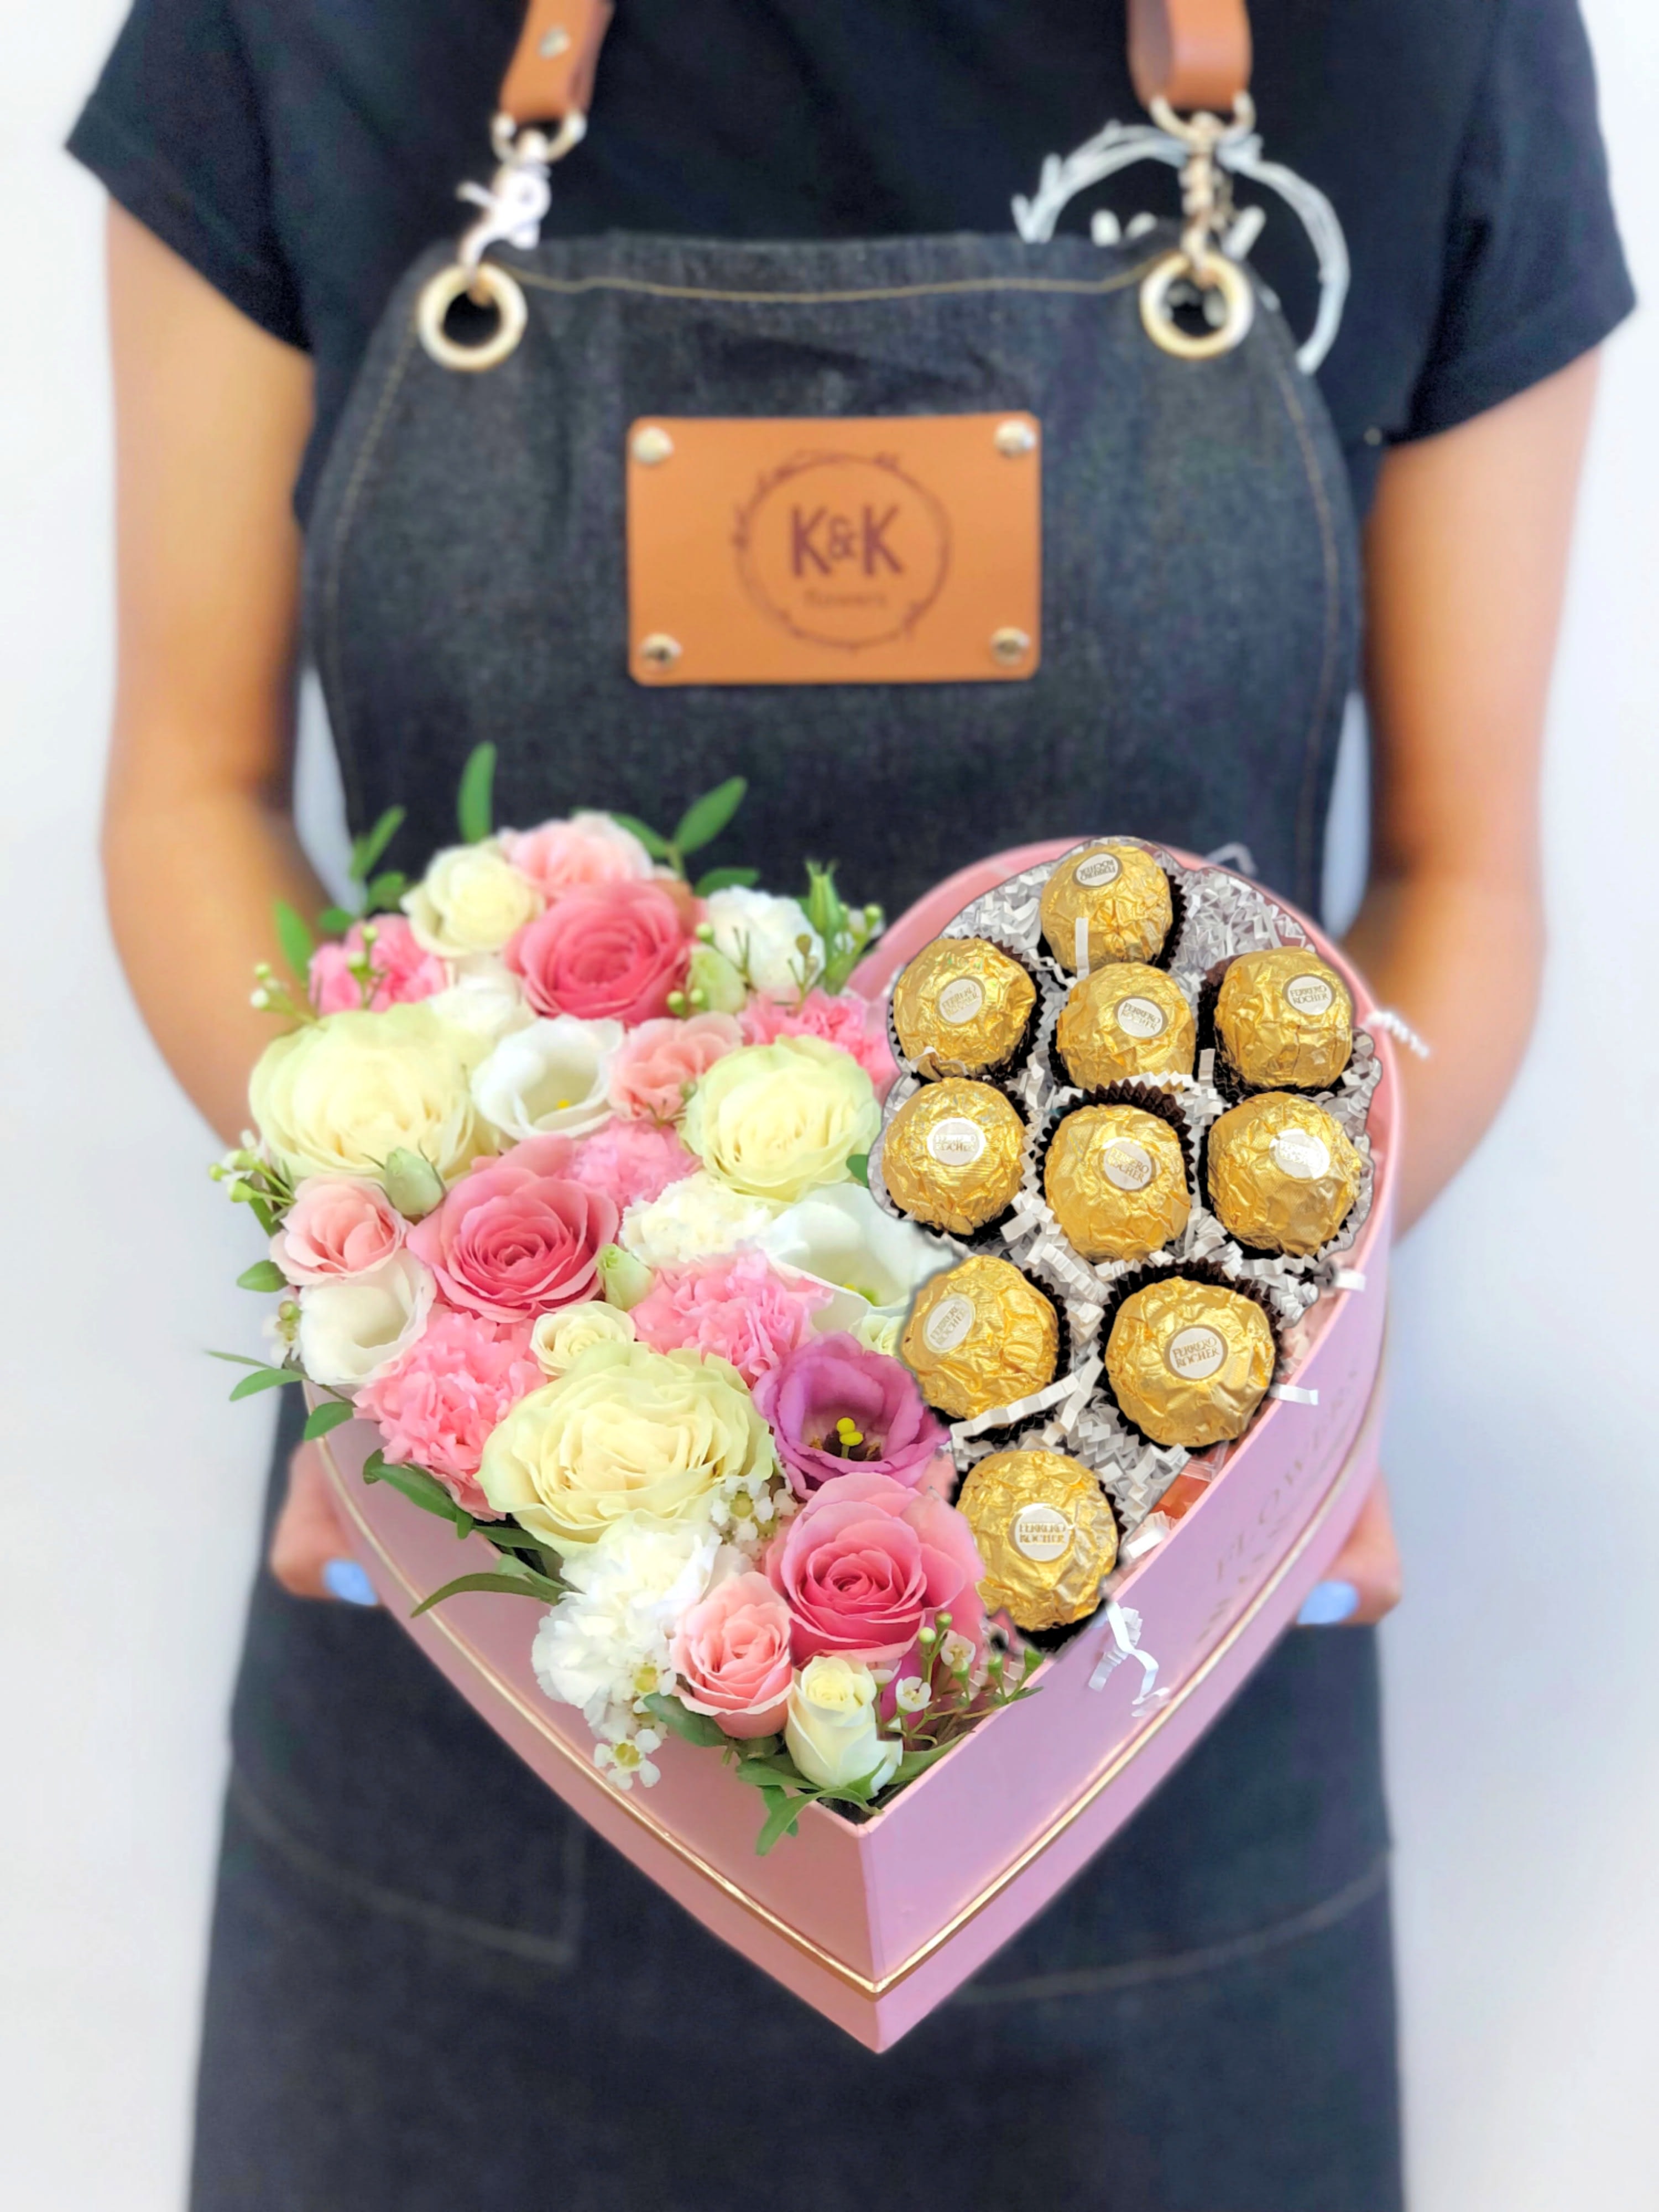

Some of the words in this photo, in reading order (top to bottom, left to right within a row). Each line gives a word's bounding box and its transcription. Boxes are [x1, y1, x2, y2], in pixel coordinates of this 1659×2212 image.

[791, 504, 904, 577] K&K
[1290, 985, 1327, 998] FERRERO
[1292, 992, 1329, 1004] ROCHER
[1123, 1003, 1161, 1024] FERRERO
[1172, 1338, 1218, 1360] FERRERO
[1176, 1349, 1220, 1369] ROCHER
[1019, 1522, 1067, 1533] FERRERO
[1019, 1534, 1066, 1545] ROCHER
